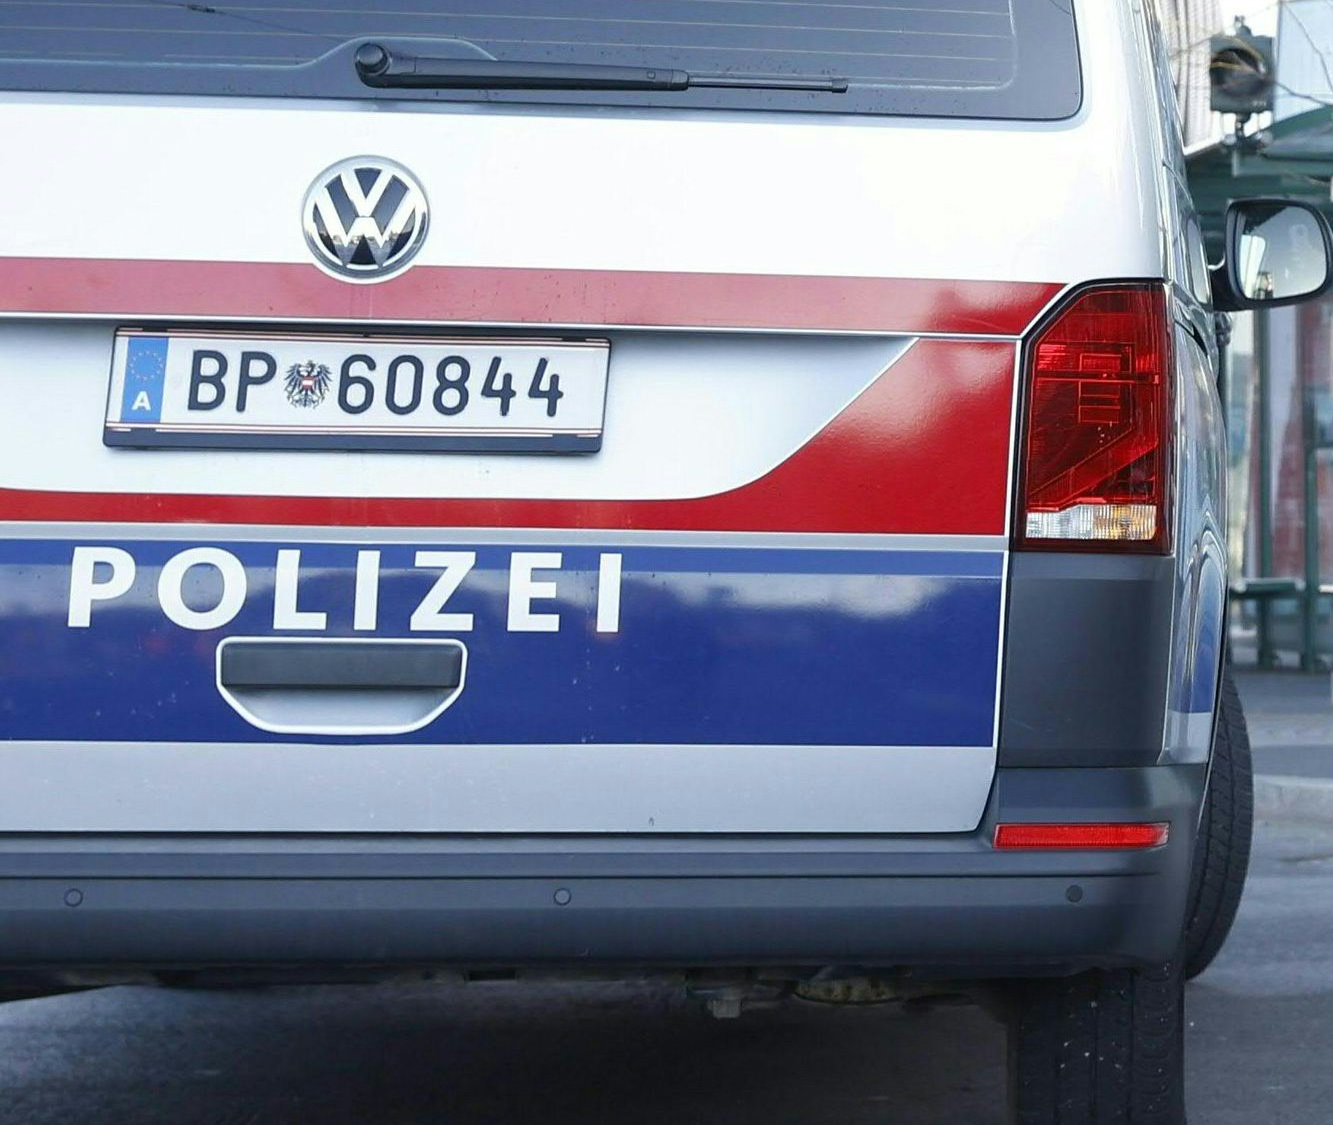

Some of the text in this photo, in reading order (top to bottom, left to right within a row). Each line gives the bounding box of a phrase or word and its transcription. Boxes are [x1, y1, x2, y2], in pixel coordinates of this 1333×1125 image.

[131, 392, 152, 411] A
[187, 350, 564, 417] BP 60844
[66, 546, 623, 633] POLIZEI
